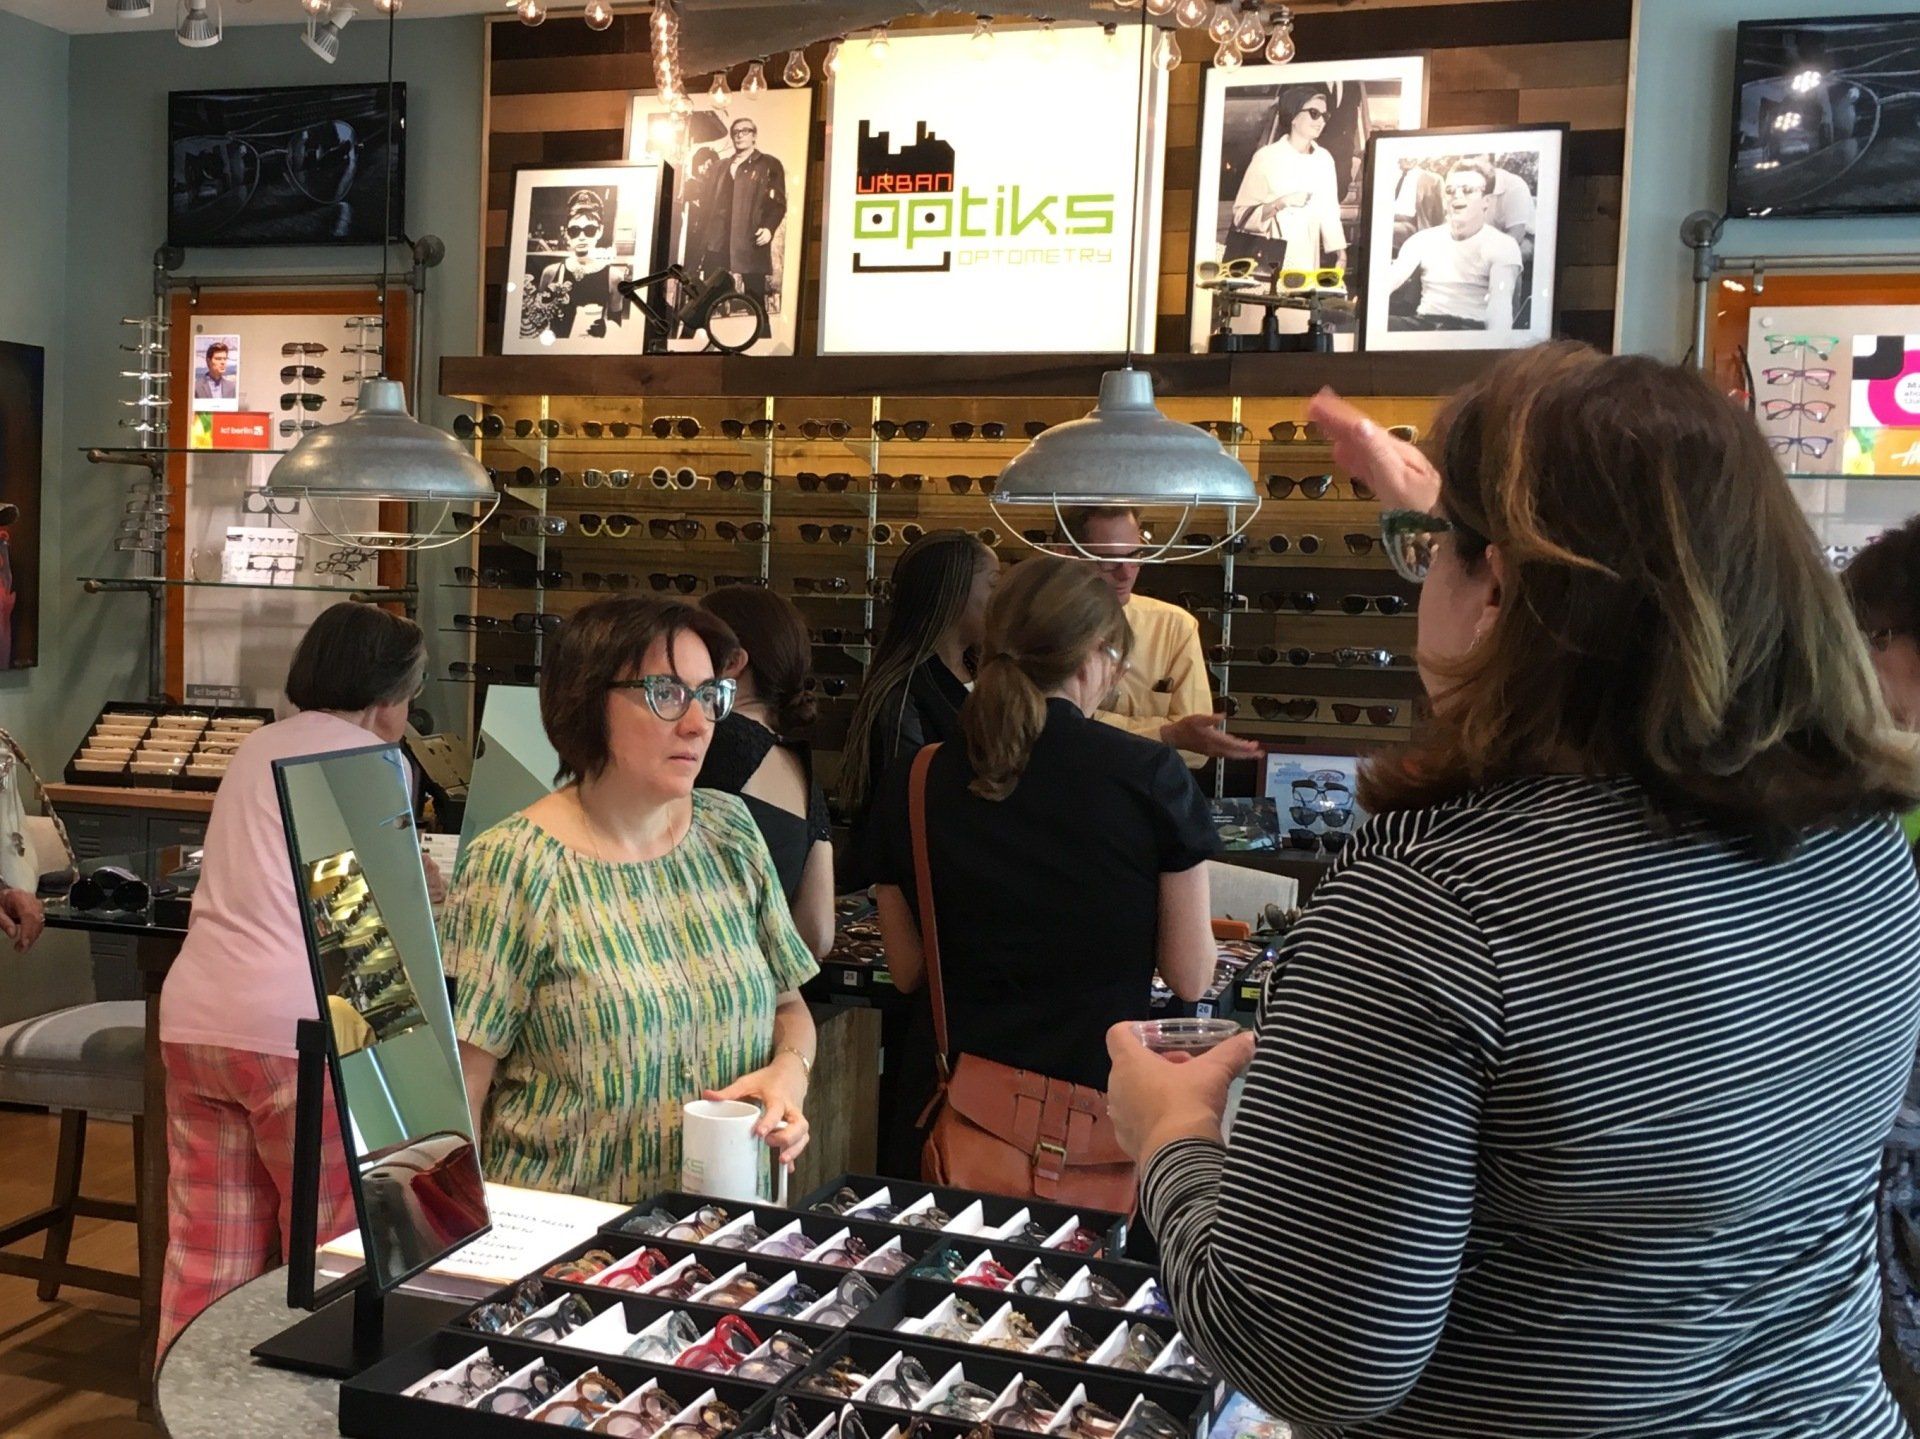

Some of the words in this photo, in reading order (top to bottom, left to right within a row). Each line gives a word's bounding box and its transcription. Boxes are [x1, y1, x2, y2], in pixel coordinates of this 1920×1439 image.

[857, 173, 952, 193] URBAN
[854, 185, 1114, 249] optiks
[958, 248, 1112, 265] OPTOMETRY
[1198, 1004, 1209, 1014] 26
